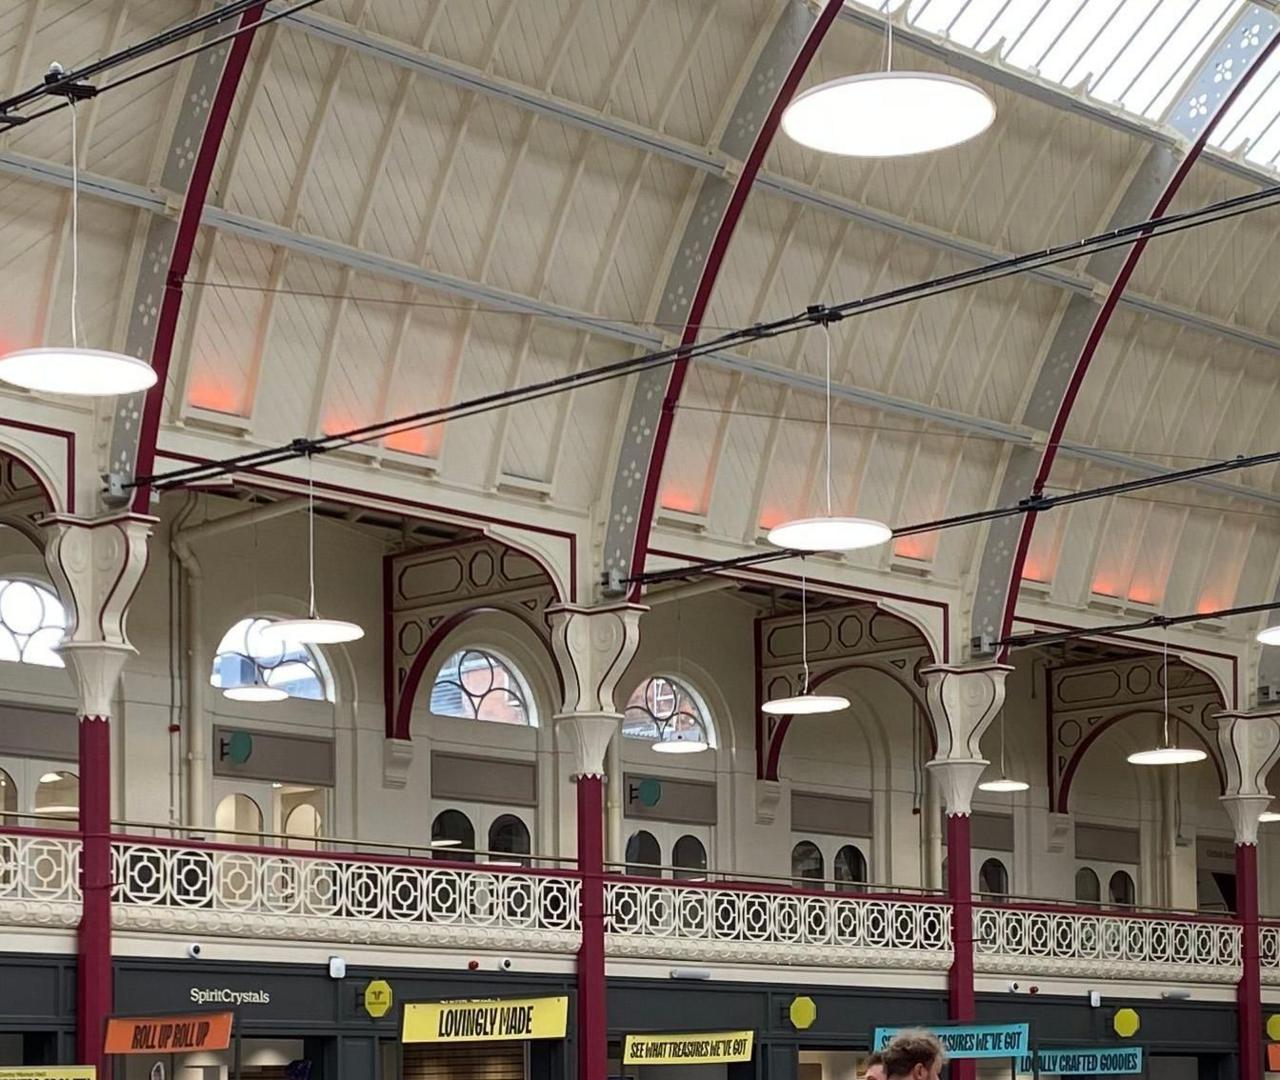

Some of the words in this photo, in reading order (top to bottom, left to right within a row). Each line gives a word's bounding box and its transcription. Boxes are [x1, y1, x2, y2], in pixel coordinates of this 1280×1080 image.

[190, 987, 270, 1005] SpiritCrystals
[438, 1007, 497, 1038] LOVINGLY
[498, 1005, 534, 1036] MADE
[131, 1024, 156, 1049] ROLL
[158, 1023, 173, 1049] UP
[173, 1022, 195, 1048] ROLL
[196, 1021, 210, 1047] UP
[976, 1032, 1003, 1051] WE'VE
[1003, 1031, 1022, 1050] GOT
[630, 1042, 645, 1058] SEE
[645, 1041, 667, 1058] WHAT
[668, 1040, 710, 1058] TREASURES
[710, 1039, 732, 1057] WE'VE
[733, 1039, 748, 1055] GOT
[1020, 1055, 1057, 1073] LOALLY
[1059, 1054, 1098, 1072] CRAFTED
[1100, 1053, 1138, 1071] GOODIES
